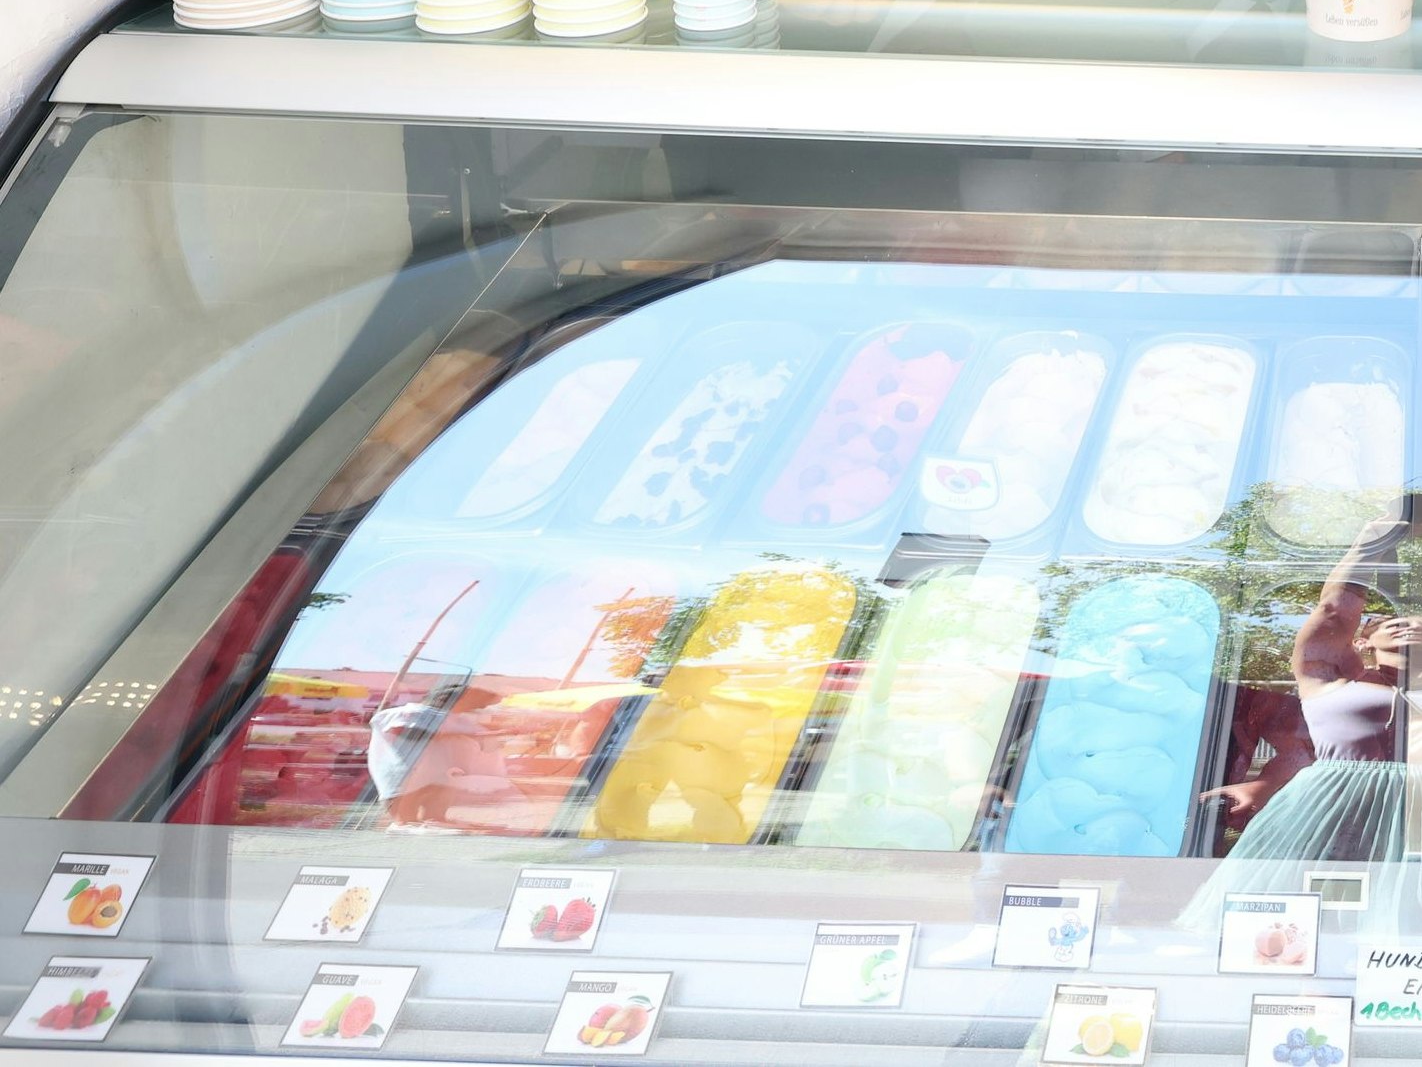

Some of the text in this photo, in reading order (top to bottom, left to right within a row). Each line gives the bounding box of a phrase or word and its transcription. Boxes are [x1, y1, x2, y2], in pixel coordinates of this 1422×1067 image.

[71, 864, 107, 875] MARILLE
[299, 875, 338, 886] MALAGA
[522, 878, 568, 889] ERDBEERE
[1008, 896, 1043, 907] BUBBLE
[1236, 902, 1282, 912] MARZIPAN
[819, 934, 887, 946] GRÜNER APFEL
[321, 974, 354, 985] GUAVE
[578, 983, 613, 994] MANGO
[1064, 994, 1107, 1005] ZITRONE
